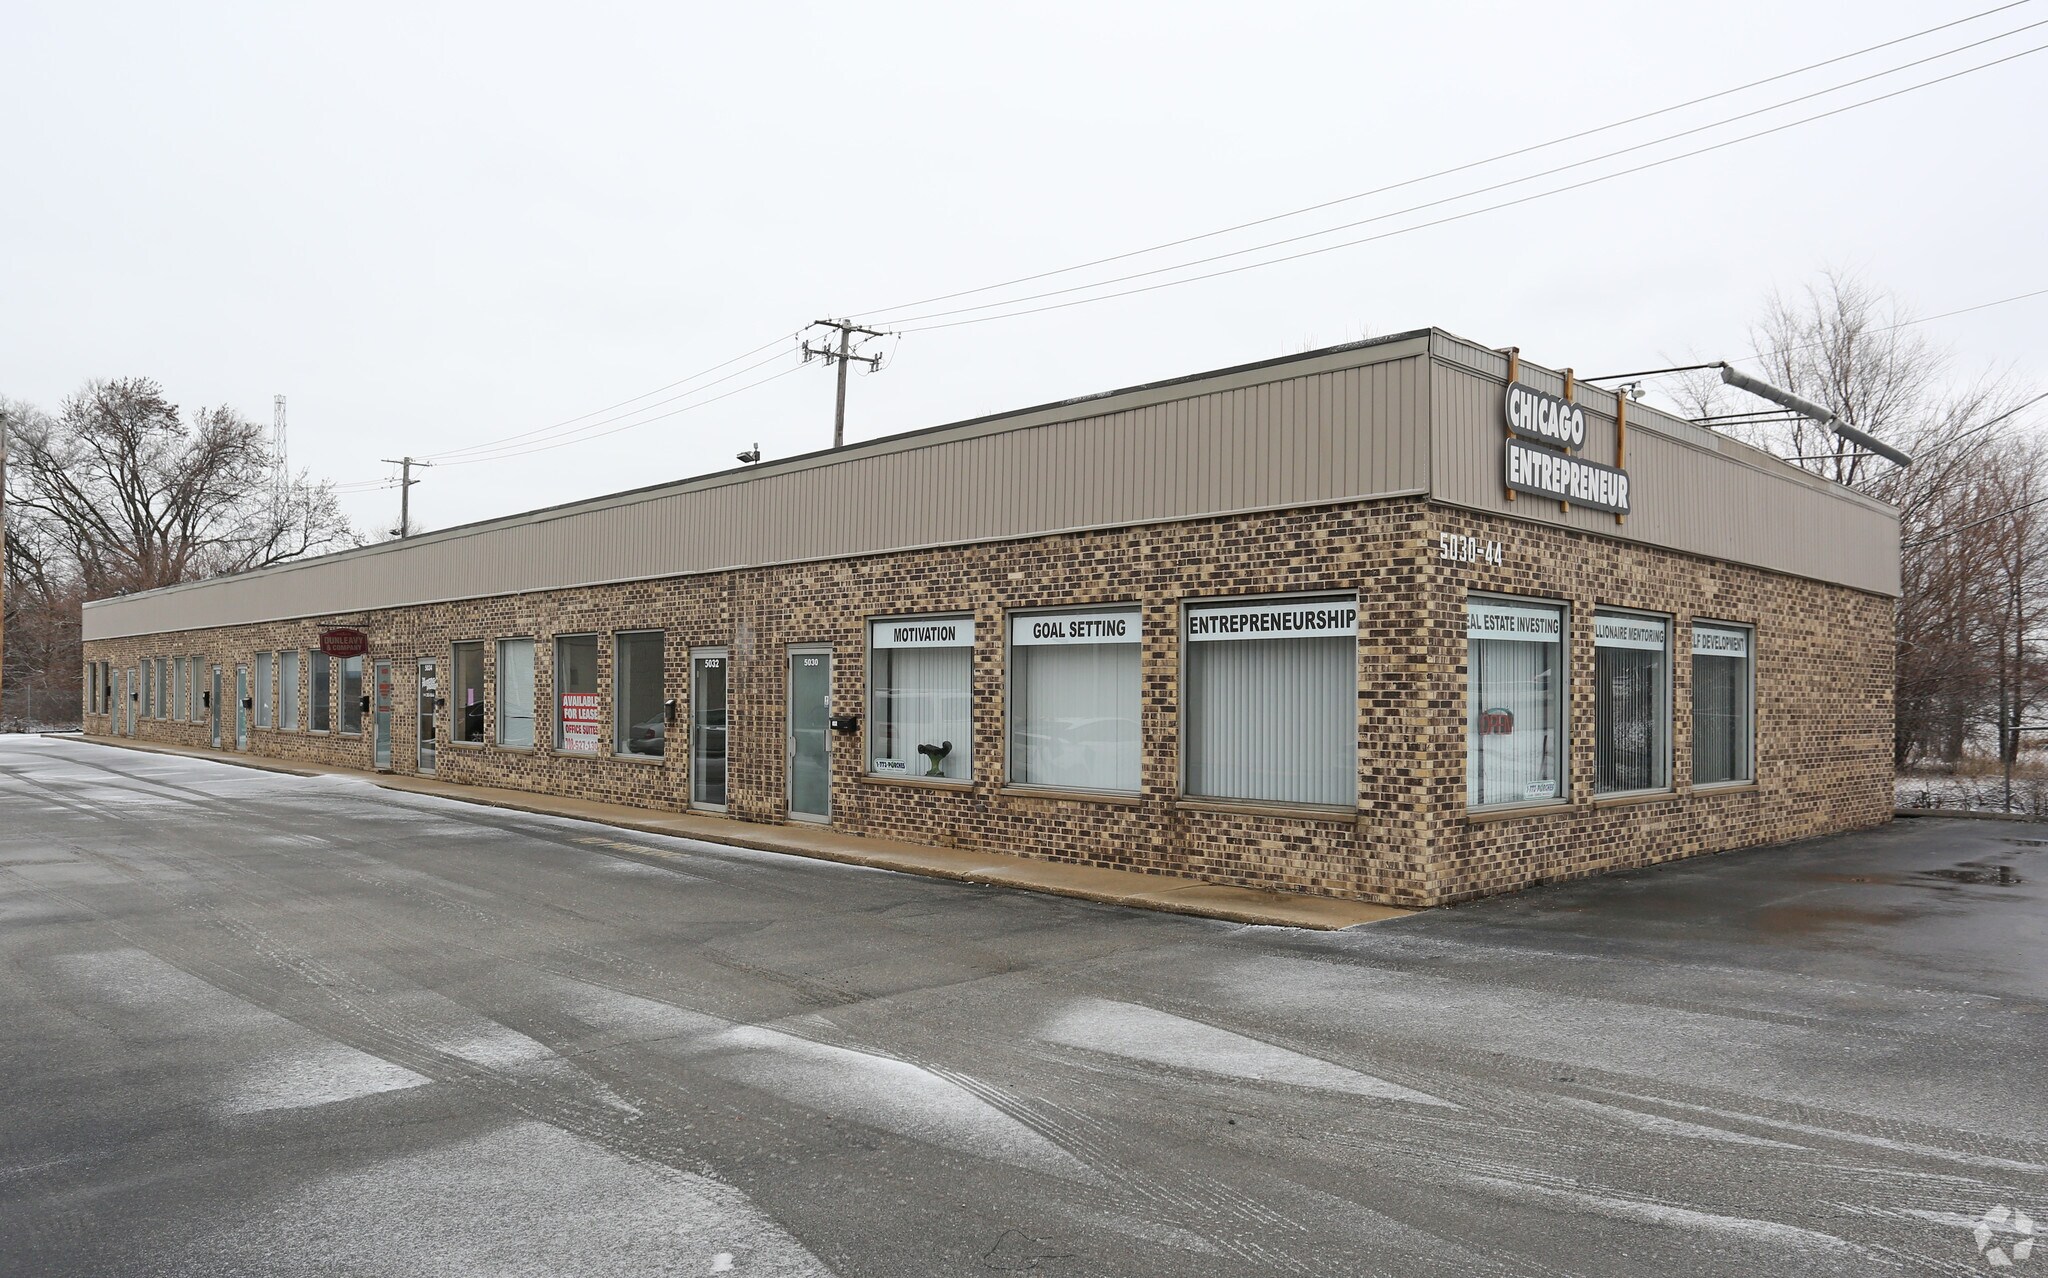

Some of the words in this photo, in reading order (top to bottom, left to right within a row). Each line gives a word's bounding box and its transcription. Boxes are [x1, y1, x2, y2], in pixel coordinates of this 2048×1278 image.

[1509, 388, 1584, 446] CHICAGO
[1509, 445, 1628, 509] ENTREPRENEUR
[1440, 532, 1502, 567] 5030-44
[1033, 622, 1066, 639] GOAL
[1069, 619, 1126, 638] SETTING
[1189, 609, 1357, 634] ENTREPRENEURSHIP
[1483, 614, 1515, 632] ESTATE
[1517, 616, 1559, 634] INVESTING
[324, 636, 363, 645] DUNLEAVY
[893, 626, 956, 643] MOTIVATION
[1628, 627, 1664, 643] MENTORING
[1702, 634, 1745, 652] DEVELOPMENT
[704, 659, 720, 668] 5032
[803, 658, 819, 667] 5030
[563, 696, 599, 707] AVAILABLE
[564, 708, 577, 719] FOR
[578, 708, 598, 720] LEASE
[565, 724, 582, 734] OFFICE
[583, 725, 598, 735] SUITES
[1480, 714, 1512, 735] OPEN
